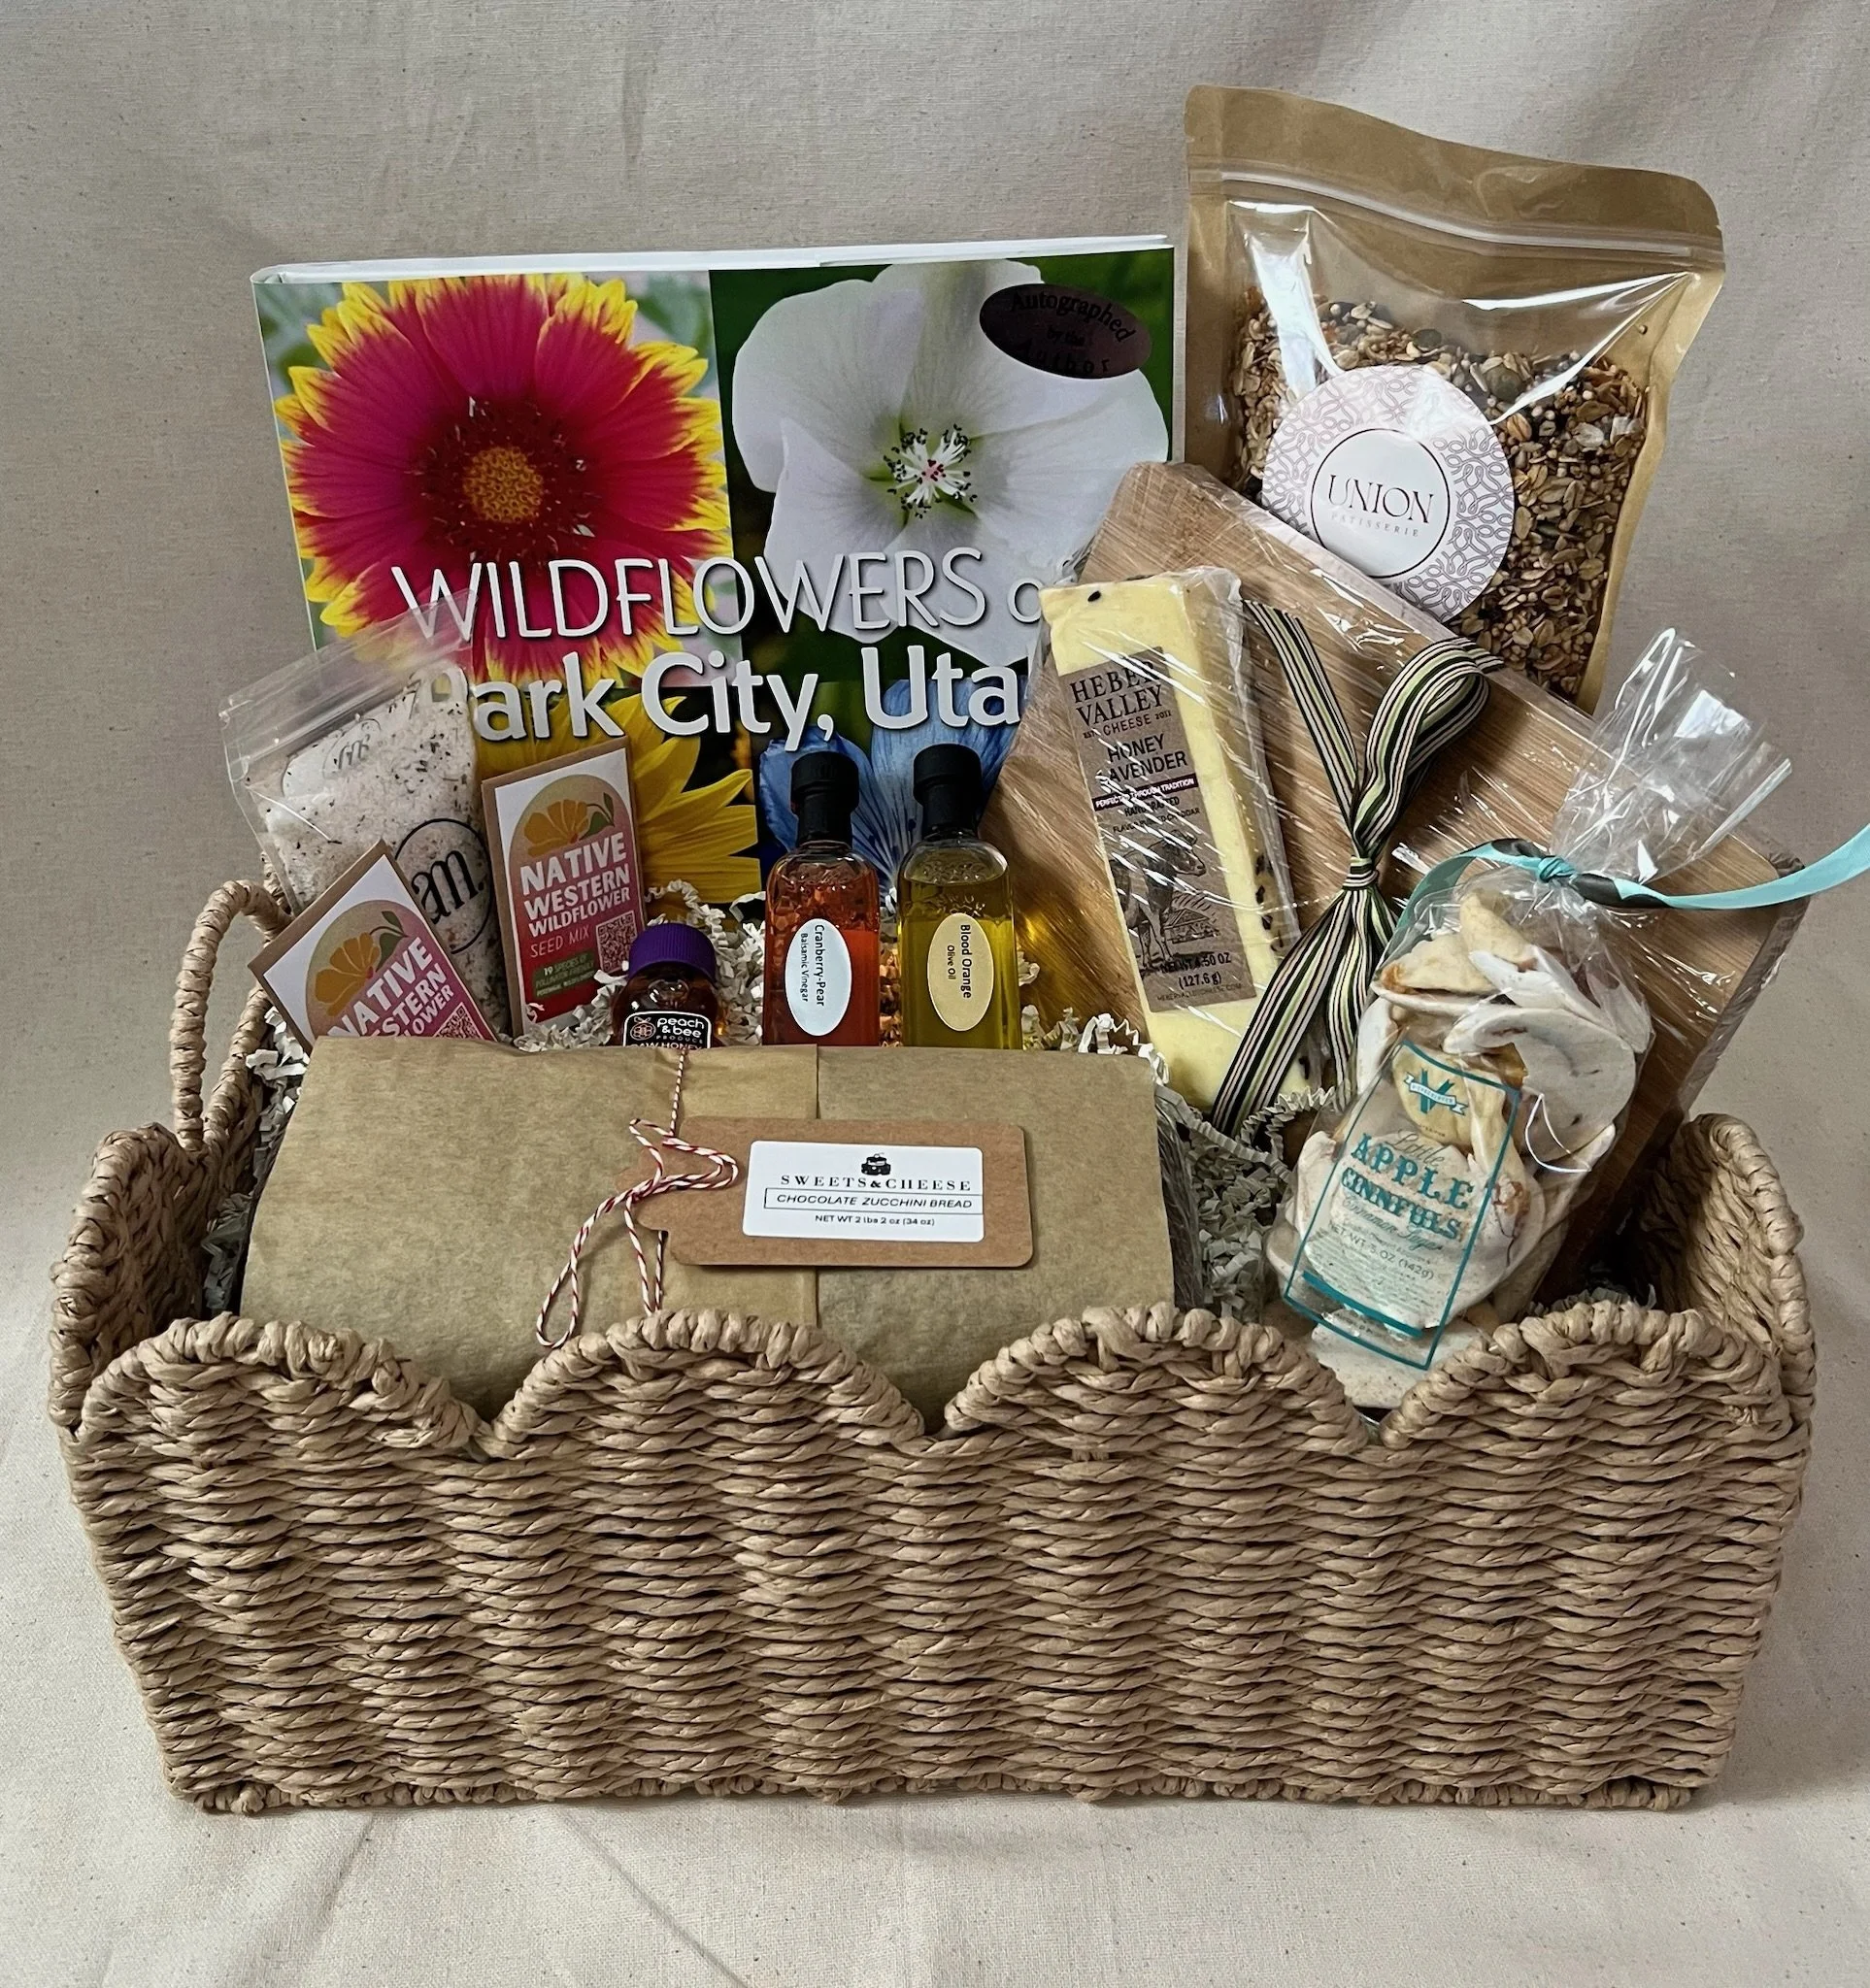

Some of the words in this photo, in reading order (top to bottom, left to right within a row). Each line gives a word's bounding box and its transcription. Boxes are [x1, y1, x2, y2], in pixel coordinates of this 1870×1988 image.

[1011, 291, 1136, 343] Autographed
[1327, 474, 1434, 524] UNION
[1330, 513, 1419, 538] PATISSERIE
[390, 547, 986, 644] WILDFLOWERS
[1007, 577, 1042, 624] o
[471, 650, 627, 742] ark
[641, 648, 835, 752] City,
[861, 644, 1020, 731] Uta
[1075, 683, 1163, 727] VALLEY
[1103, 713, 1152, 737] CHEESE
[1107, 733, 1165, 764] HONEY
[1108, 750, 1187, 782] AVENDER
[1160, 778, 1195, 792] TRADITION
[519, 831, 628, 896] NATIVE
[524, 862, 631, 921] WESTERN
[528, 886, 631, 939] WILDFLOWER
[530, 937, 564, 958] SEED
[569, 924, 590, 946] MIX
[800, 933, 810, 969] Balsamic
[947, 944, 956, 967] Olive
[960, 924, 973, 956] Blood
[813, 924, 826, 1007] Cranberry-Pear
[948, 968, 957, 980] Oil
[1218, 951, 1232, 965] OZ
[799, 970, 810, 1003] Vinegar
[960, 958, 973, 999] Orange
[1178, 972, 1211, 990] (127.6
[1211, 971, 1222, 986] g)
[656, 1017, 705, 1030] peach
[1384, 1128, 1445, 1167] Little
[1351, 1132, 1475, 1210] APPLE
[776, 1193, 857, 1207] CHOCOLATE
[861, 1195, 927, 1209] ZUCCHINI
[929, 1198, 973, 1209] BREAD
[815, 1214, 835, 1223] NET
[854, 1215, 861, 1224] 2
[880, 1216, 887, 1225] 2
[902, 1217, 918, 1227] (34
[919, 1218, 935, 1227] oz)
